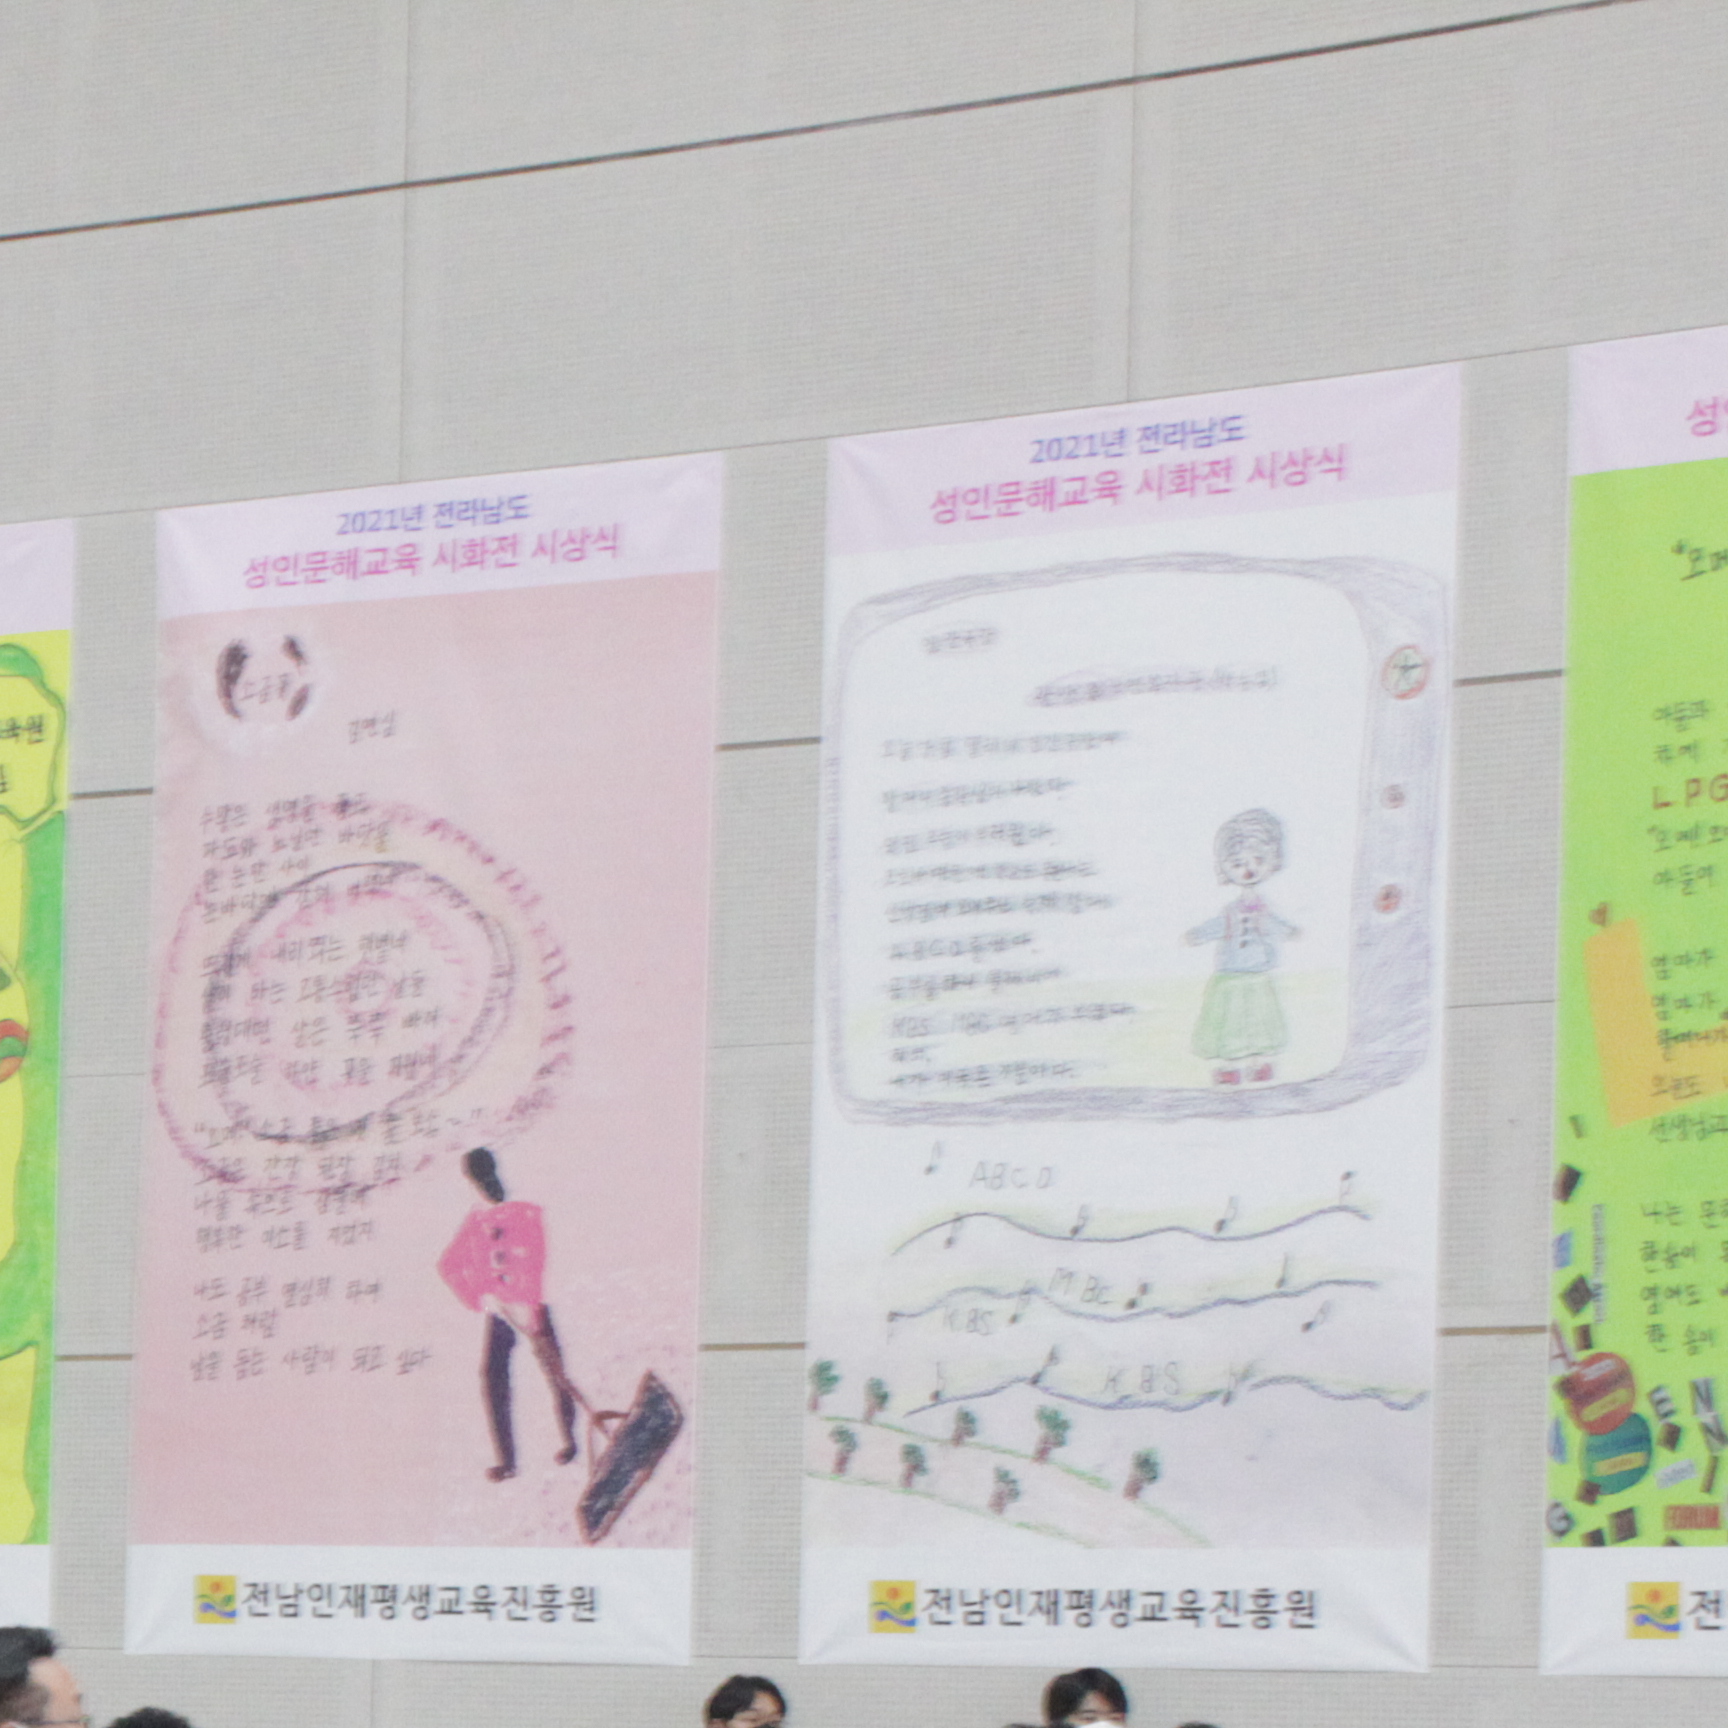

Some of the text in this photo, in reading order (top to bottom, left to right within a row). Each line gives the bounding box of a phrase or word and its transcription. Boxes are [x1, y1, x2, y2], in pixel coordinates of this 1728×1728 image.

[1685, 396, 1728, 437] 성
[1029, 415, 1249, 464] 2021년 전라남도
[931, 442, 1348, 525] 성인문해교육 시화전 시상식
[336, 495, 532, 536] 2021년 전라남도
[244, 522, 623, 588] 성인문해교육 시화전 시상식
[243, 1581, 602, 1623] 전남인재평생교육진흥원
[921, 1587, 1318, 1630] 전남인재평생교육진흥원
